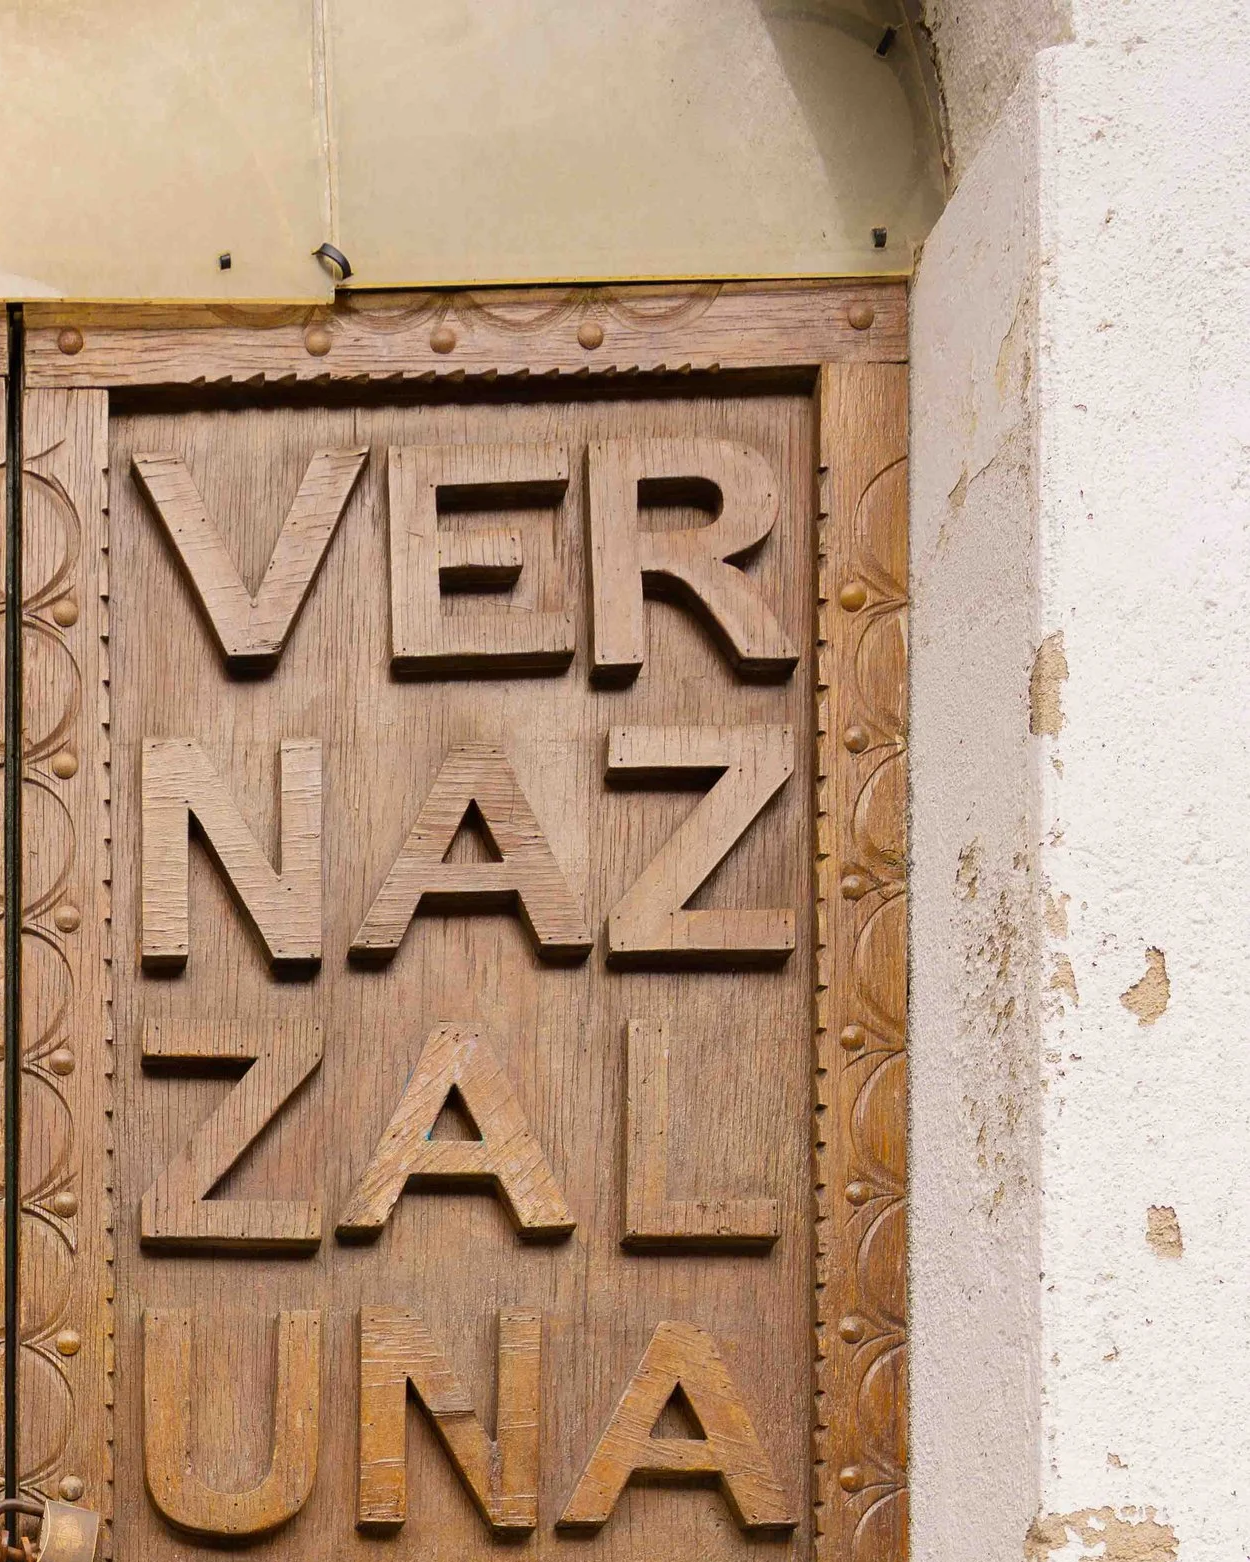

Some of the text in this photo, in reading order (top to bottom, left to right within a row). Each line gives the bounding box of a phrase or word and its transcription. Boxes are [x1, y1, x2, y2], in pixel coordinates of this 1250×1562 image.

[131, 436, 799, 683] VER
[141, 724, 796, 970] NAZ
[140, 1018, 782, 1249] ZAL
[143, 1306, 799, 1536] UNA
